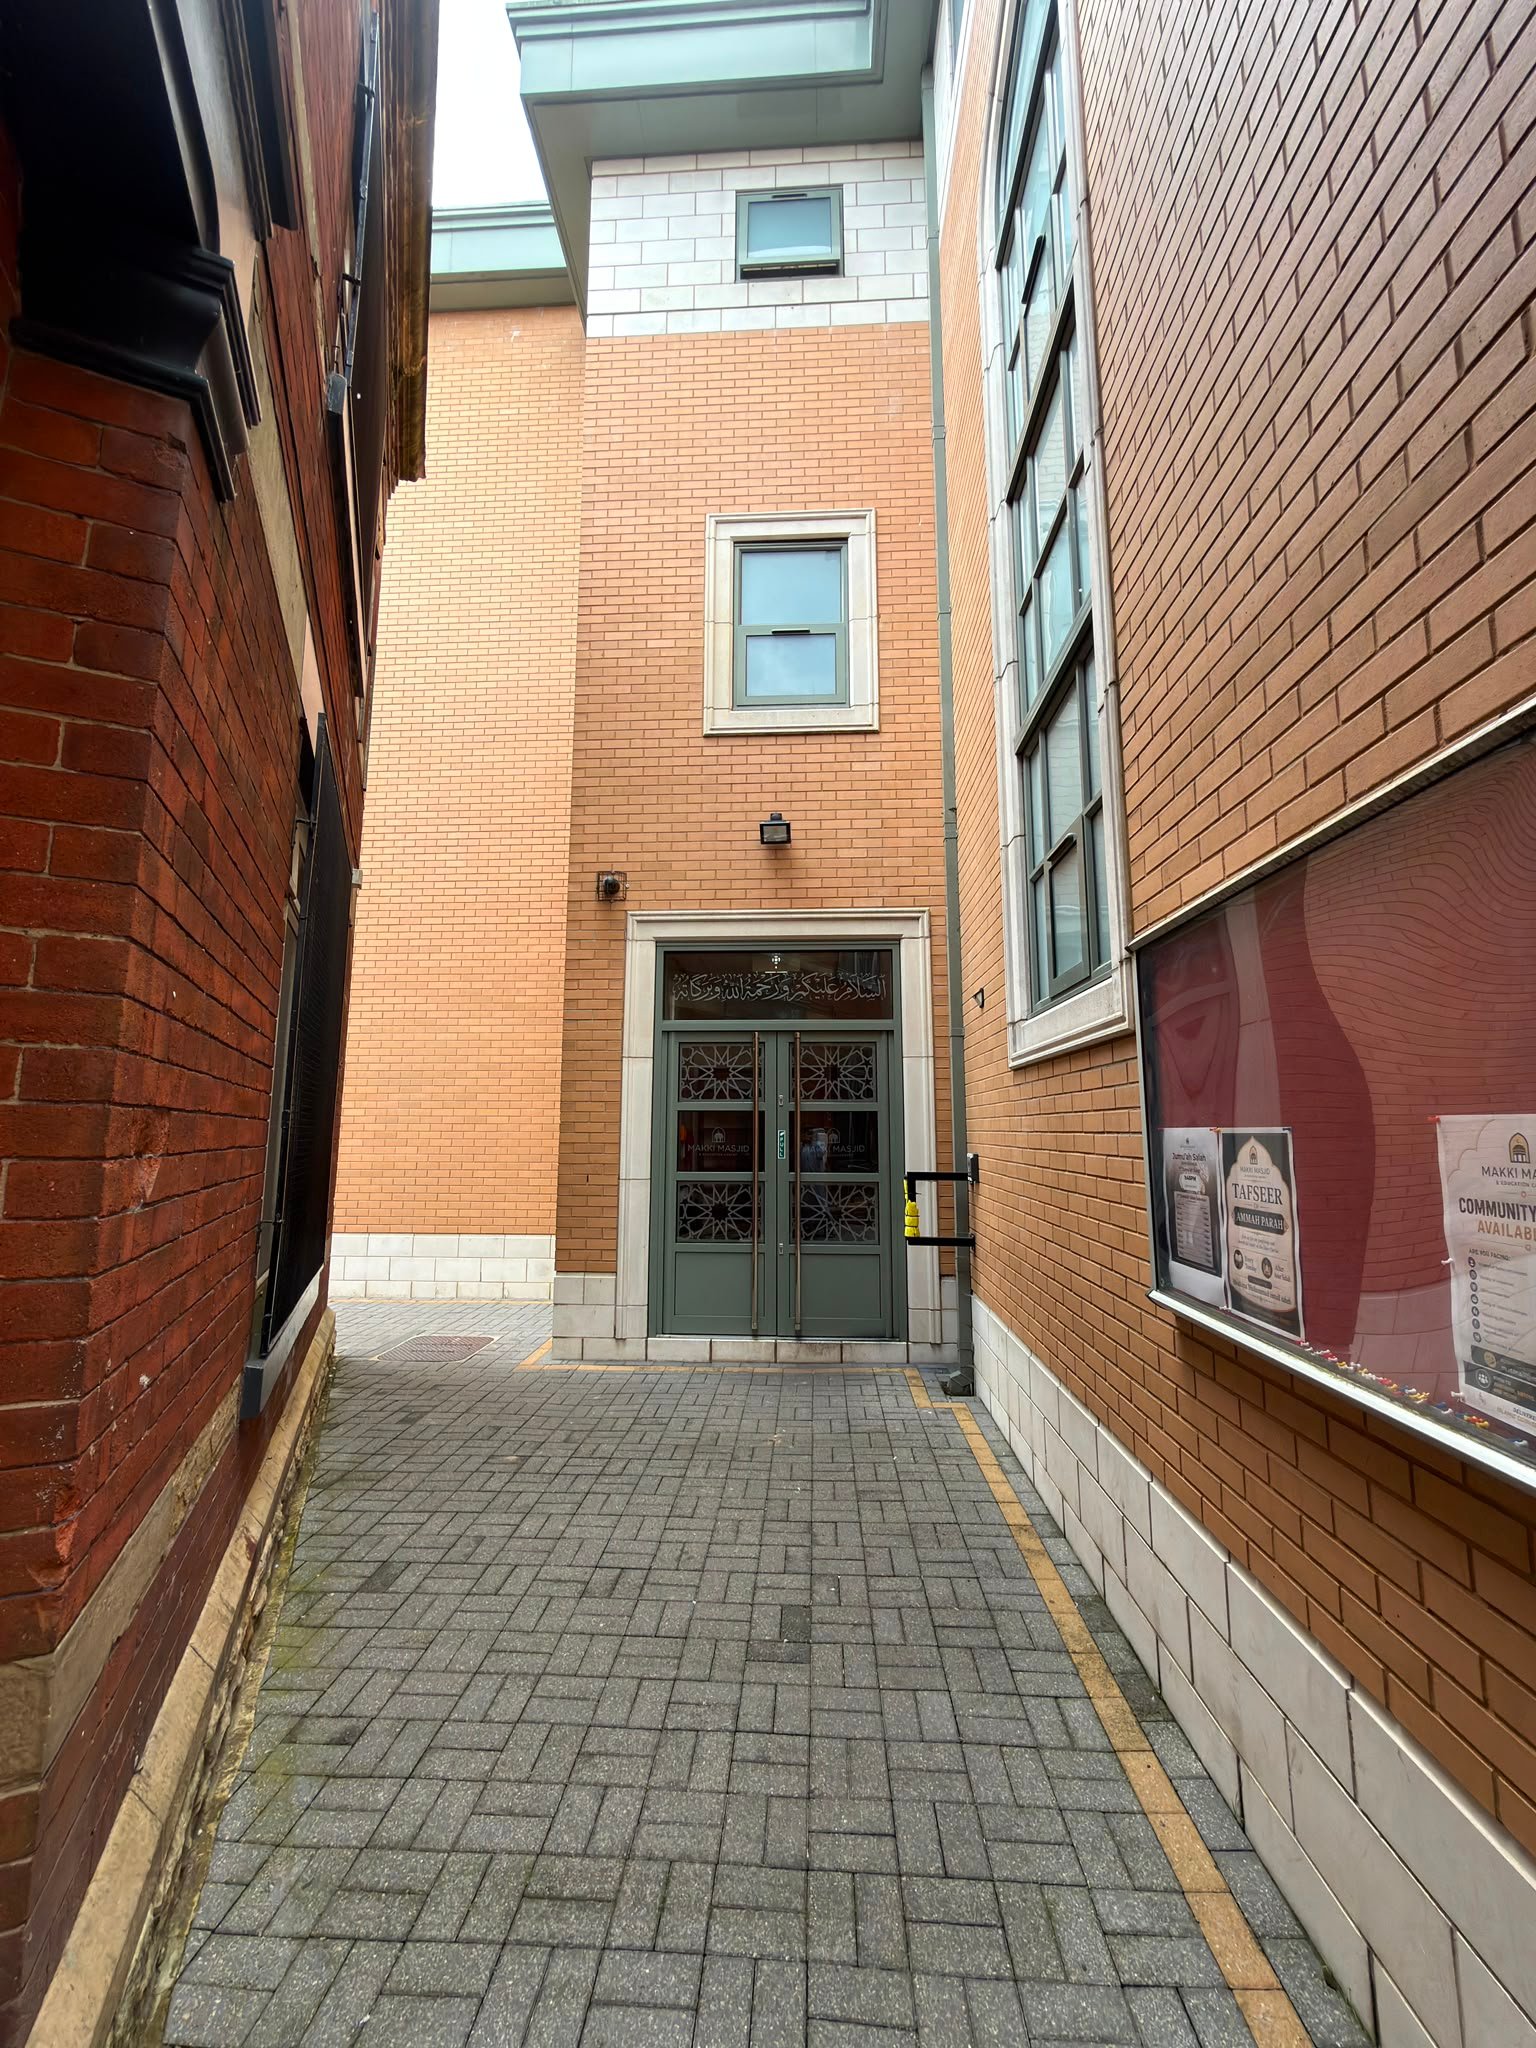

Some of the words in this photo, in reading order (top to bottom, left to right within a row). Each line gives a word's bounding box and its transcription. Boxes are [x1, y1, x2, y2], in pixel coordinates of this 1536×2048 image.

[687, 1144, 716, 1152] MAKKI
[717, 1144, 750, 1152] MASJID
[832, 1145, 866, 1153] MASJID
[1481, 1165, 1518, 1179] MAKKI
[1231, 1182, 1283, 1206] TAFSEER
[1458, 1197, 1536, 1223] COMMUNITY
[1236, 1211, 1260, 1224] AMMAH
[1260, 1216, 1284, 1230] PARAH
[1469, 1248, 1479, 1256] ARE
